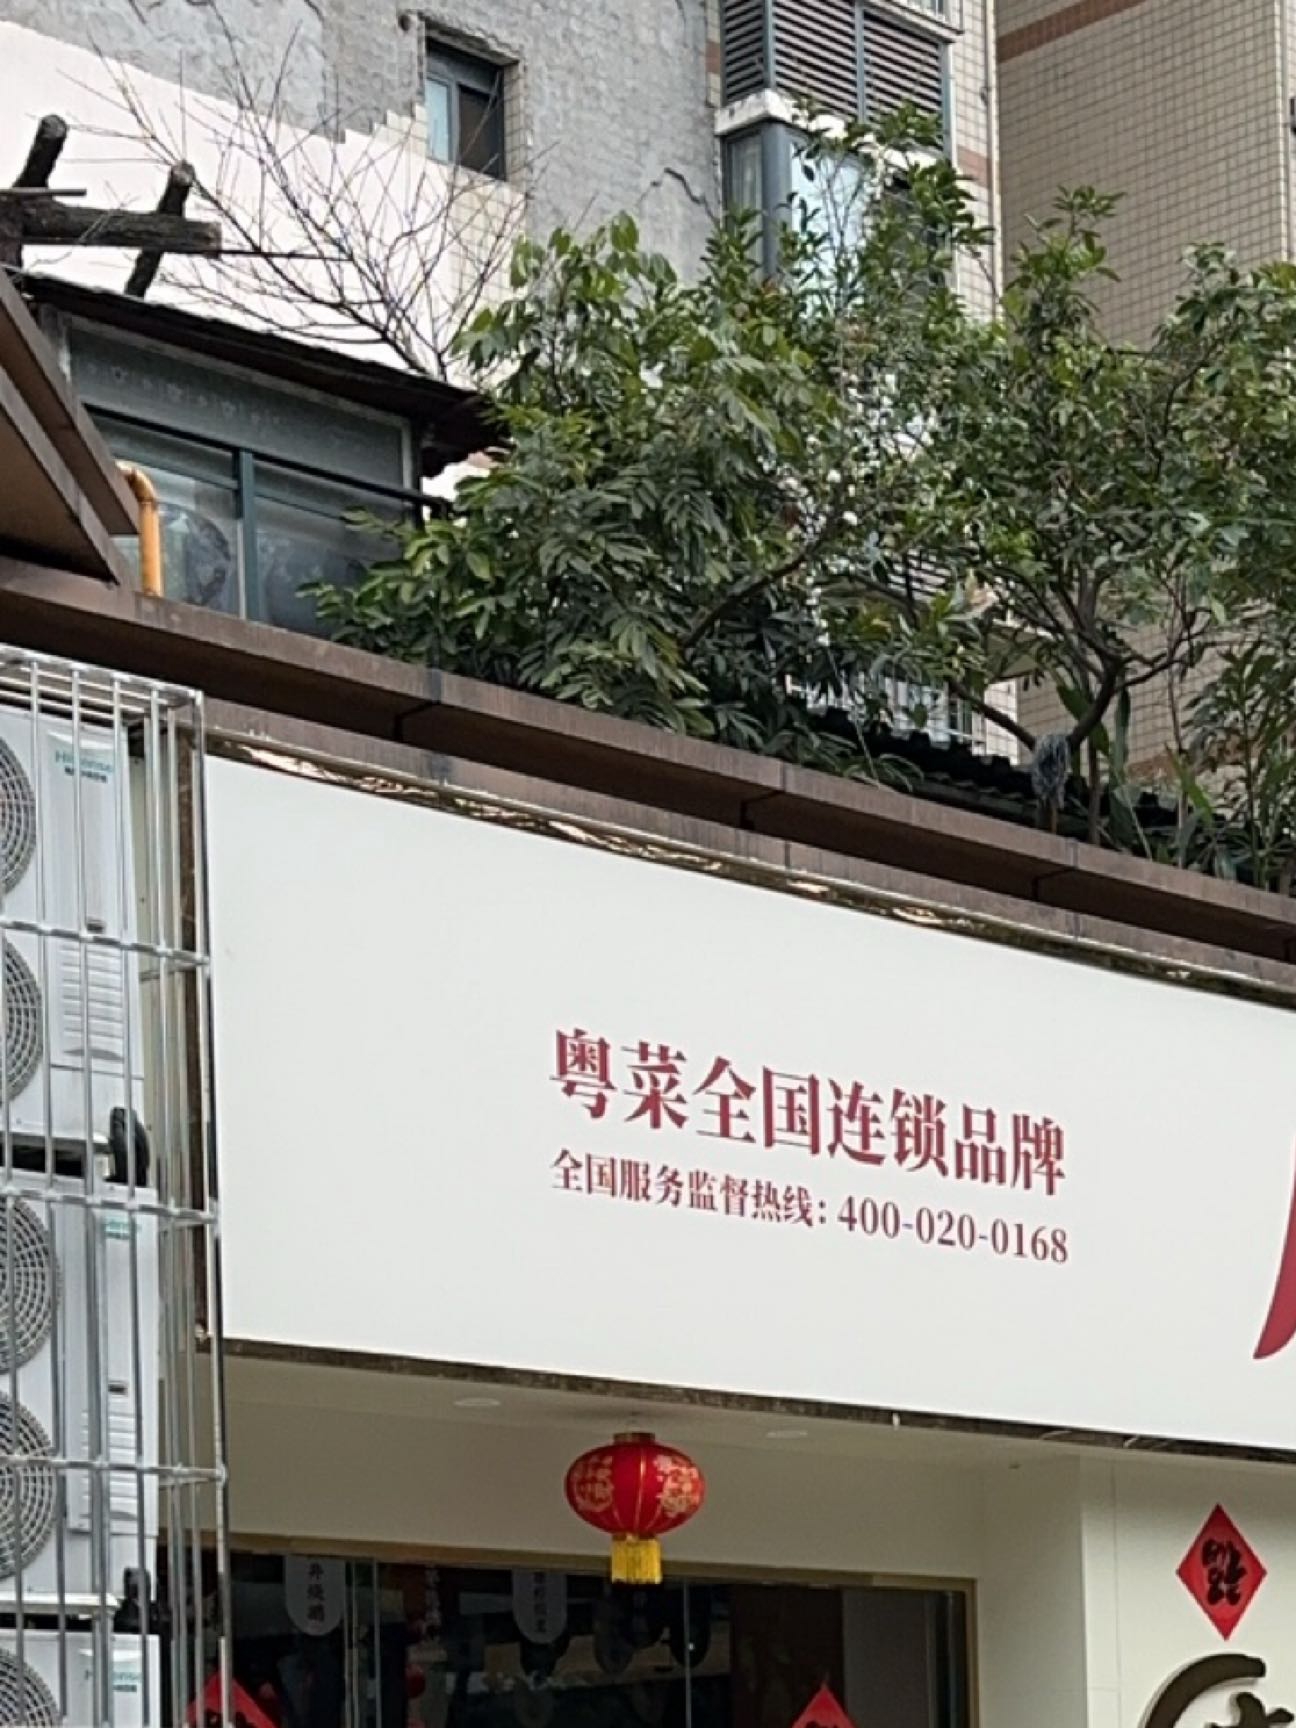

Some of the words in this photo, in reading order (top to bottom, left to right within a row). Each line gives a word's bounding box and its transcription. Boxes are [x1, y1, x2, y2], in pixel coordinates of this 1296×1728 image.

[549, 1028, 1066, 1196] 粤菜全国连锁品牌
